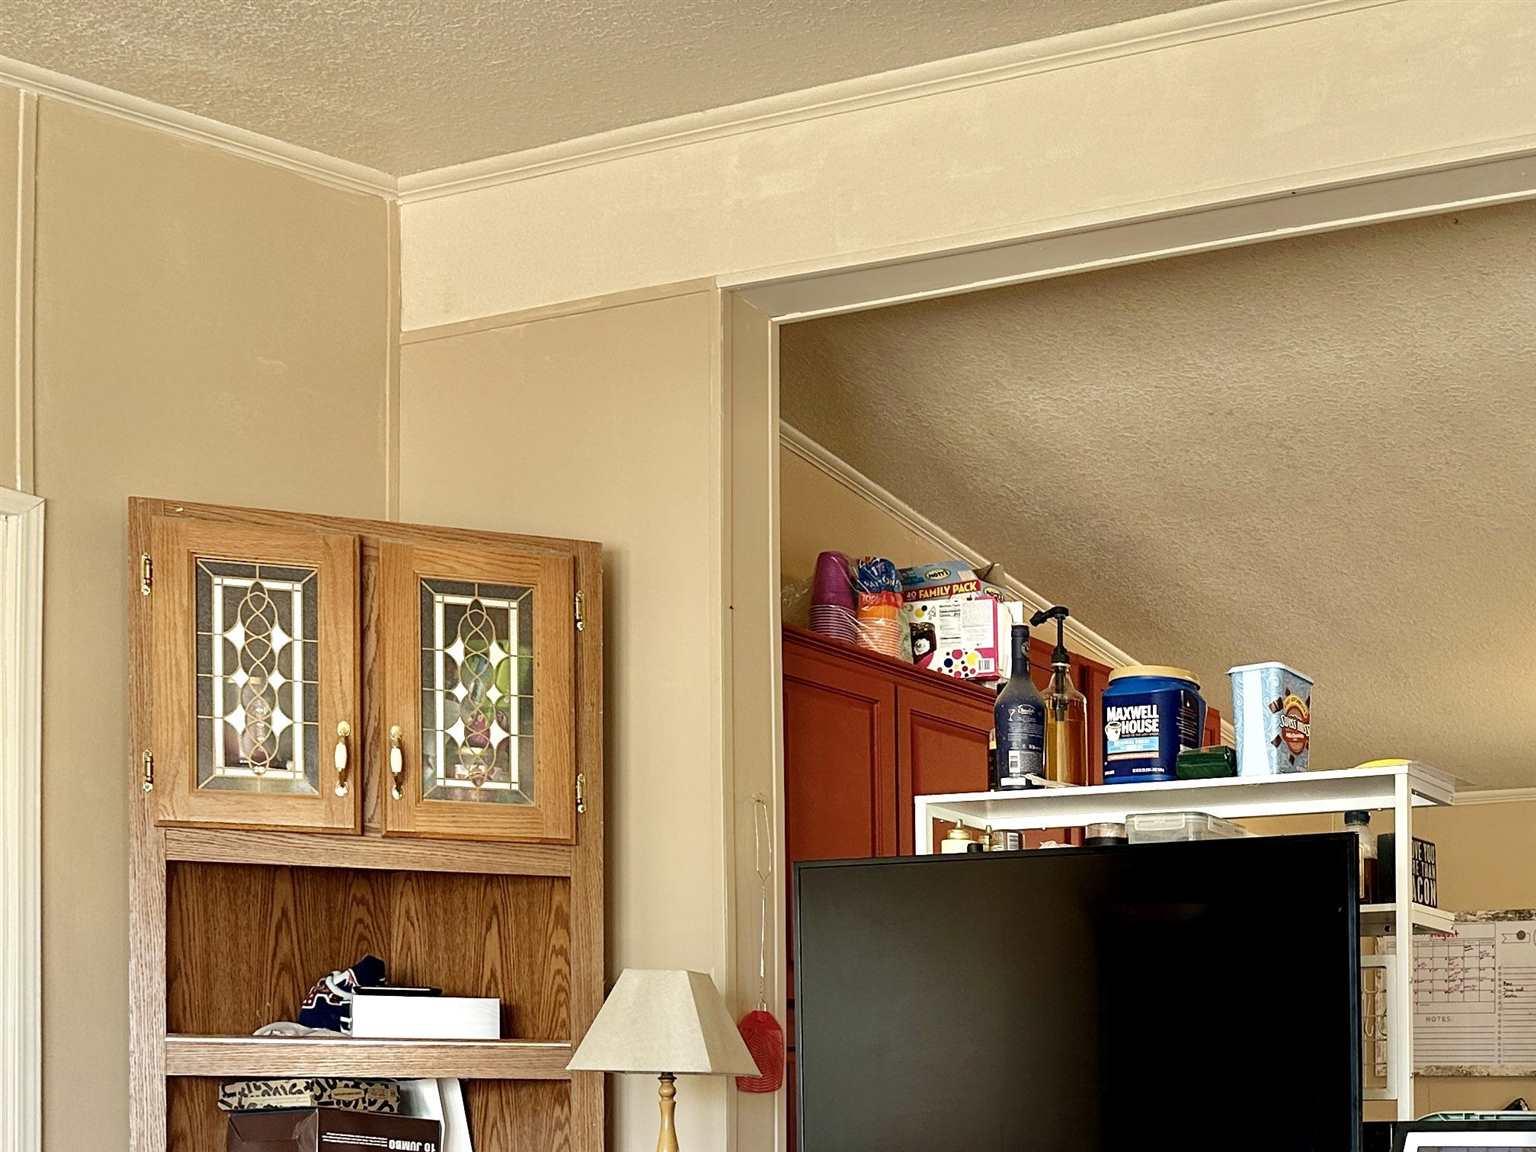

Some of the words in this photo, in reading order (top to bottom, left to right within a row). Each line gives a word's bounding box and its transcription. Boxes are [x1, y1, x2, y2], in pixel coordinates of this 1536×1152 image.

[918, 585, 951, 599] FAMILY
[952, 581, 978, 594] PACK
[1106, 704, 1160, 722] MAXWELL
[1121, 719, 1160, 735] HOUSE
[1423, 843, 1435, 864] YOU
[1412, 874, 1437, 907] ACON
[388, 1139, 423, 1152] JUMBO
[424, 1142, 436, 1152] 10
